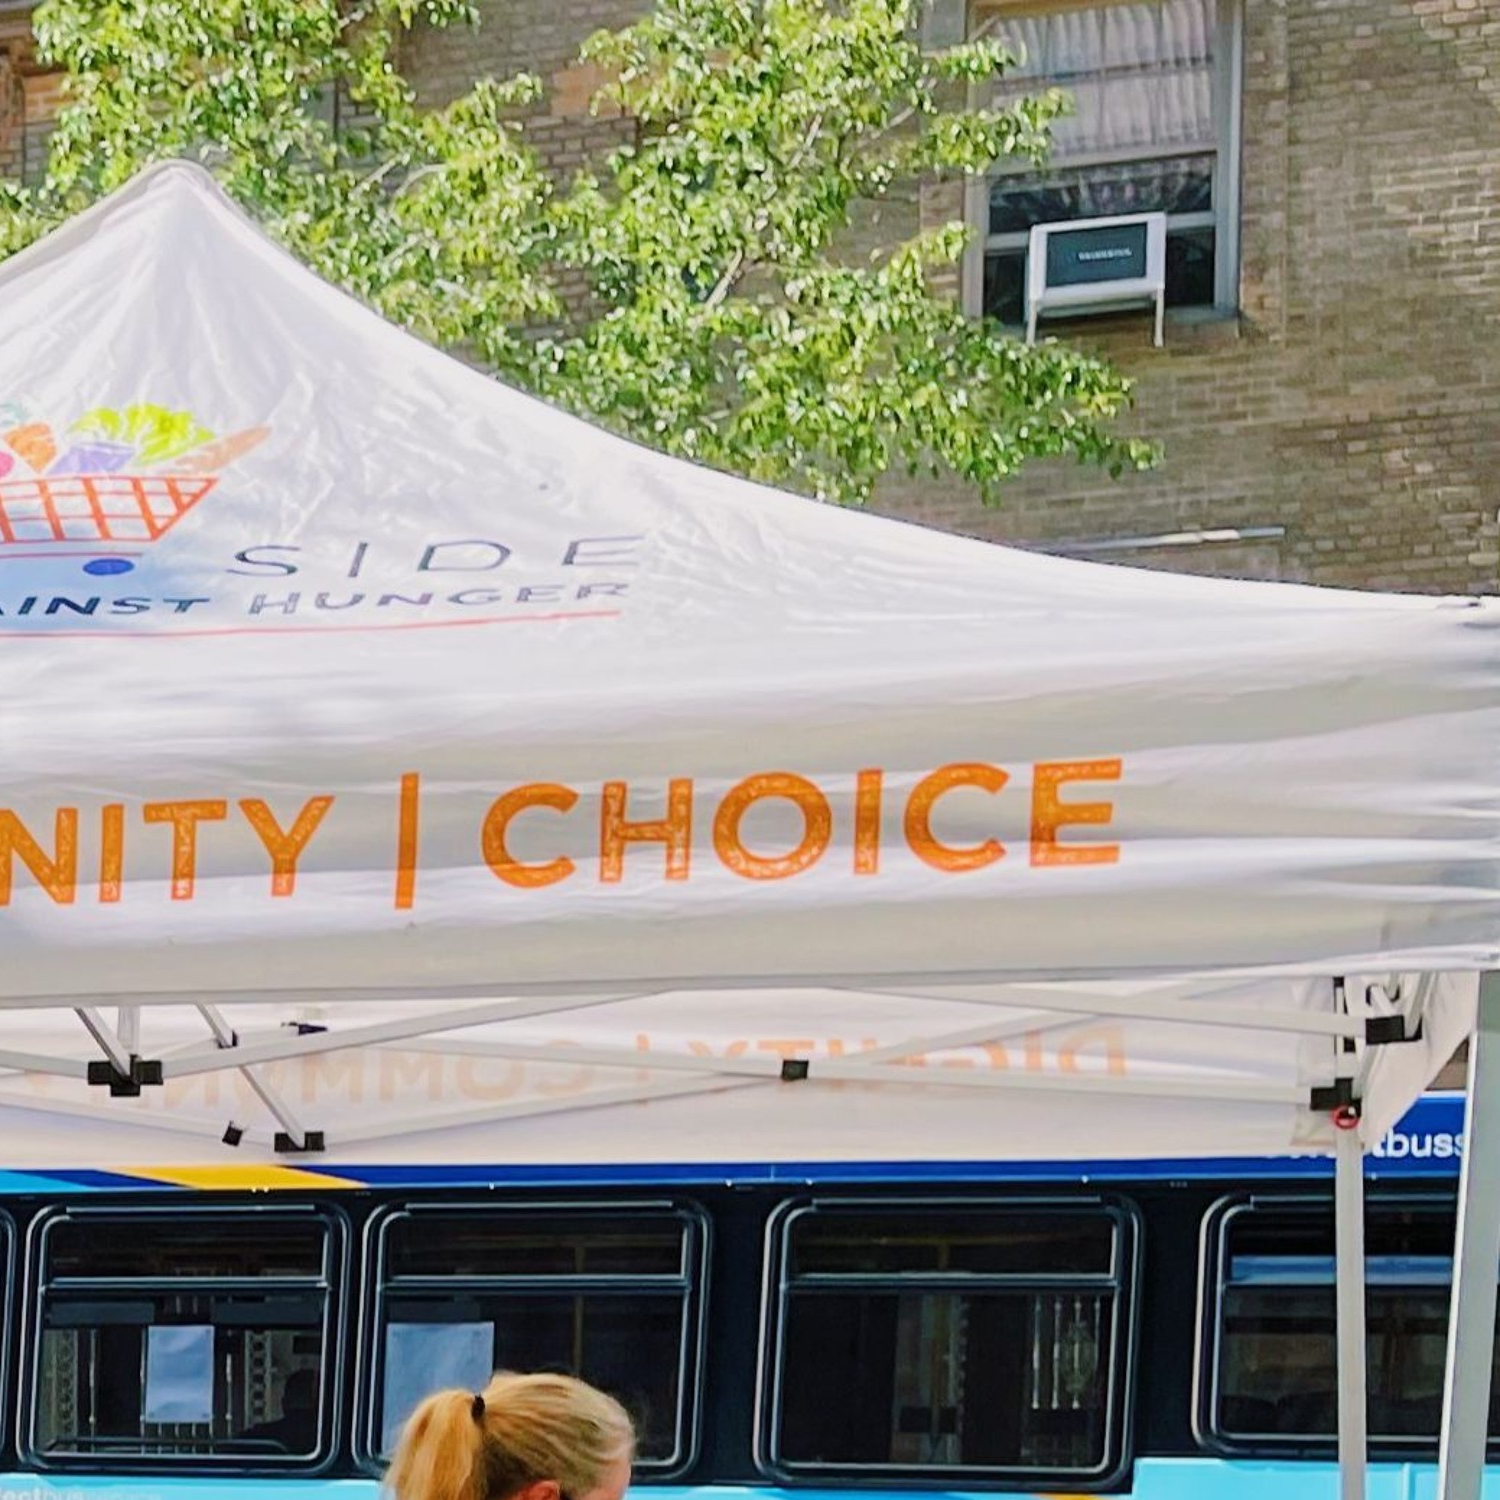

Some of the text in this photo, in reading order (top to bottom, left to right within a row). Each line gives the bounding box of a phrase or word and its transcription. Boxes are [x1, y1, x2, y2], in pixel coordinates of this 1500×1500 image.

[226, 534, 647, 580] SIDE
[249, 582, 630, 616] HUNGER
[481, 757, 1124, 890] CHOICE
